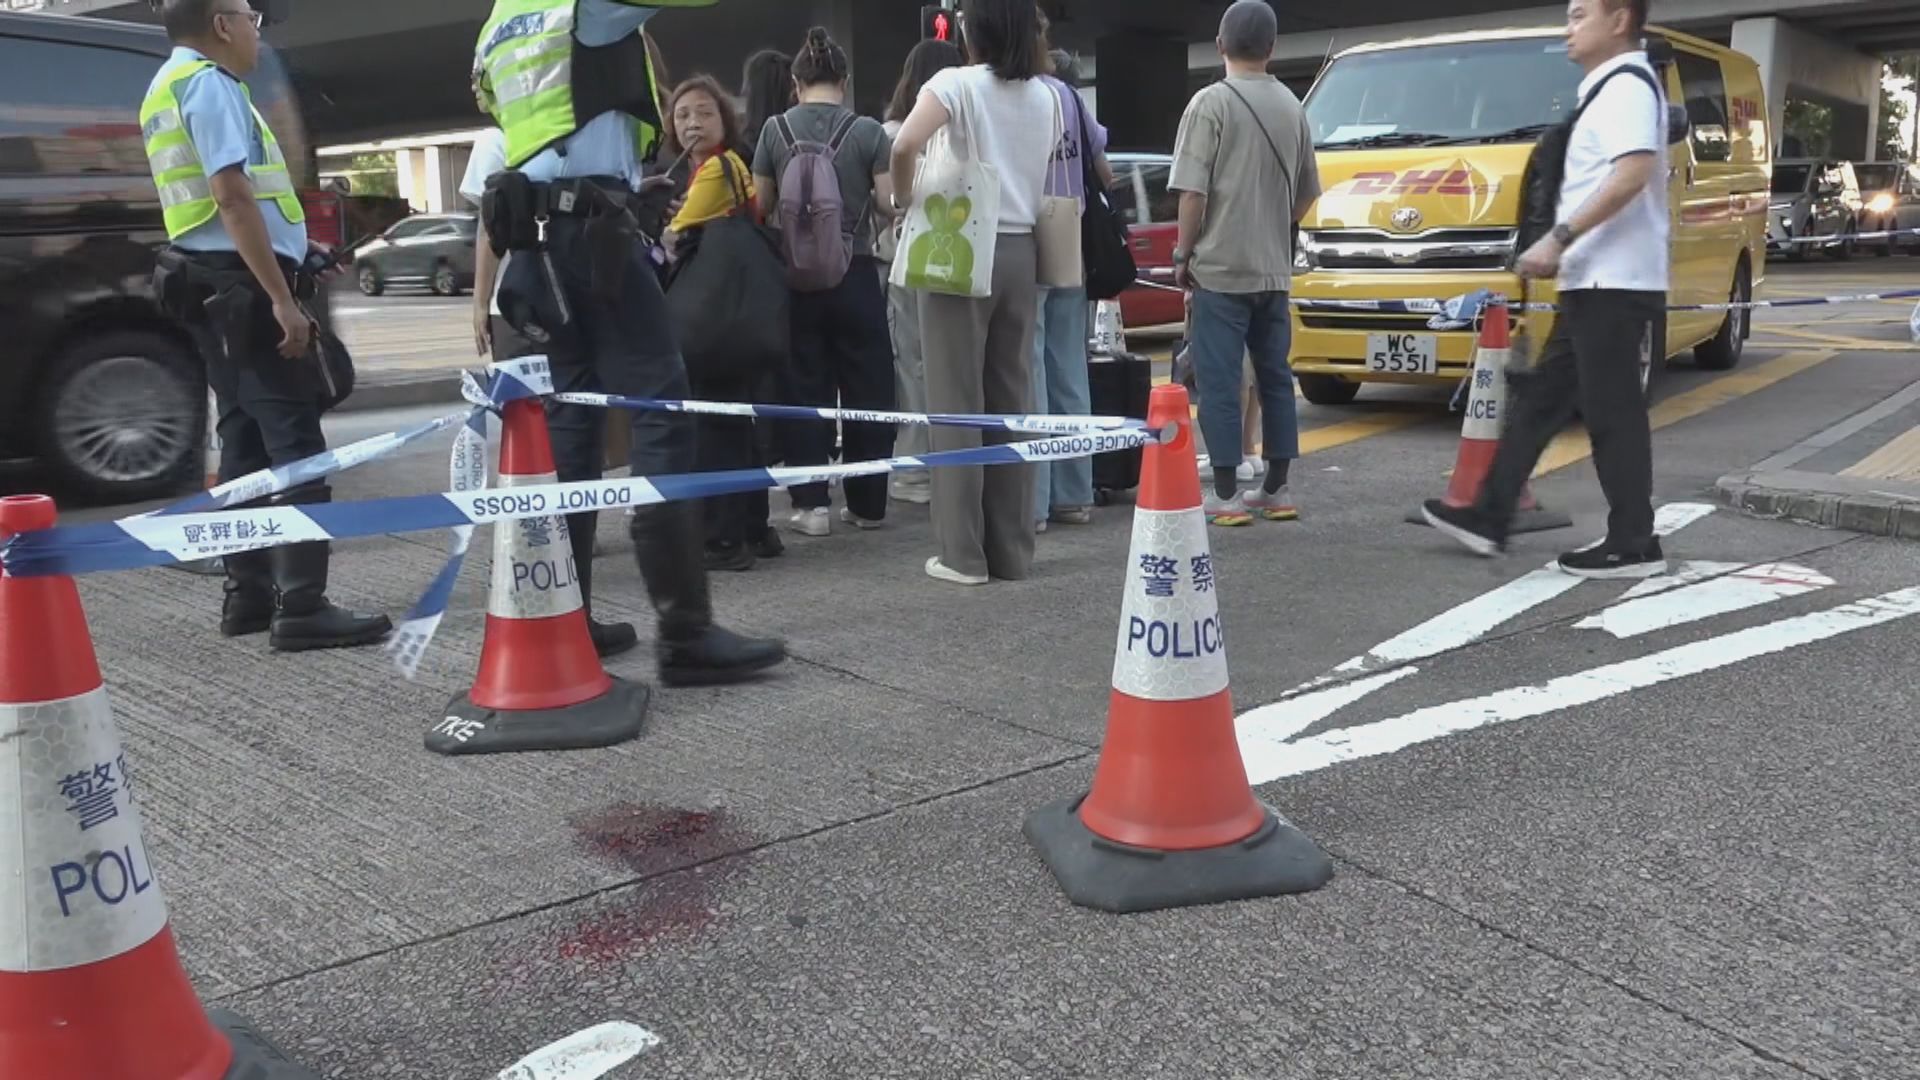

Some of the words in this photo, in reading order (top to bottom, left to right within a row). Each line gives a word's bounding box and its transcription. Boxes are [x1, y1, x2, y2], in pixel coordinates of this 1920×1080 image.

[1350, 169, 1476, 195] DHL
[1387, 334, 1417, 353] WC
[1373, 352, 1428, 372] 5551
[1475, 367, 1494, 389] 察
[1028, 437, 1092, 456] CORDON
[473, 493, 546, 516] CROSS
[557, 489, 598, 510] NOT
[602, 486, 631, 505] DO
[183, 517, 284, 544] 不得越過
[1139, 552, 1214, 598] 警察
